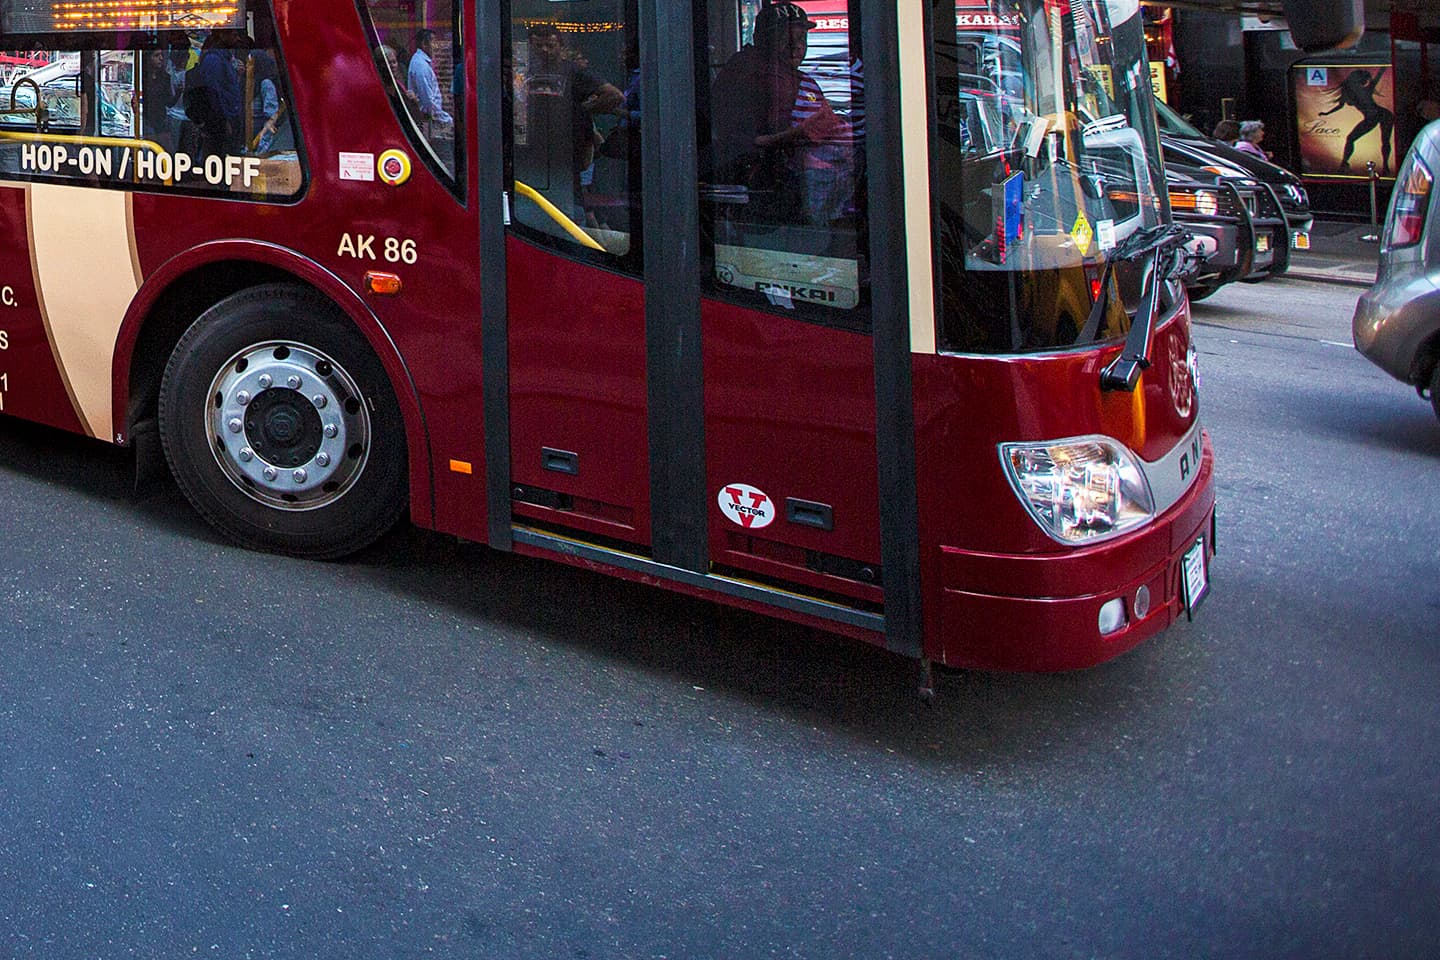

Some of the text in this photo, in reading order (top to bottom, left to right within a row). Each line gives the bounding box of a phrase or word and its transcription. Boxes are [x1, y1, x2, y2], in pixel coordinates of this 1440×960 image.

[1311, 69, 1324, 81] A
[22, 144, 113, 178] HOP-ON
[137, 151, 261, 188] HOP-OFF
[337, 232, 418, 265] AK 86
[727, 502, 766, 518] VECTOR
